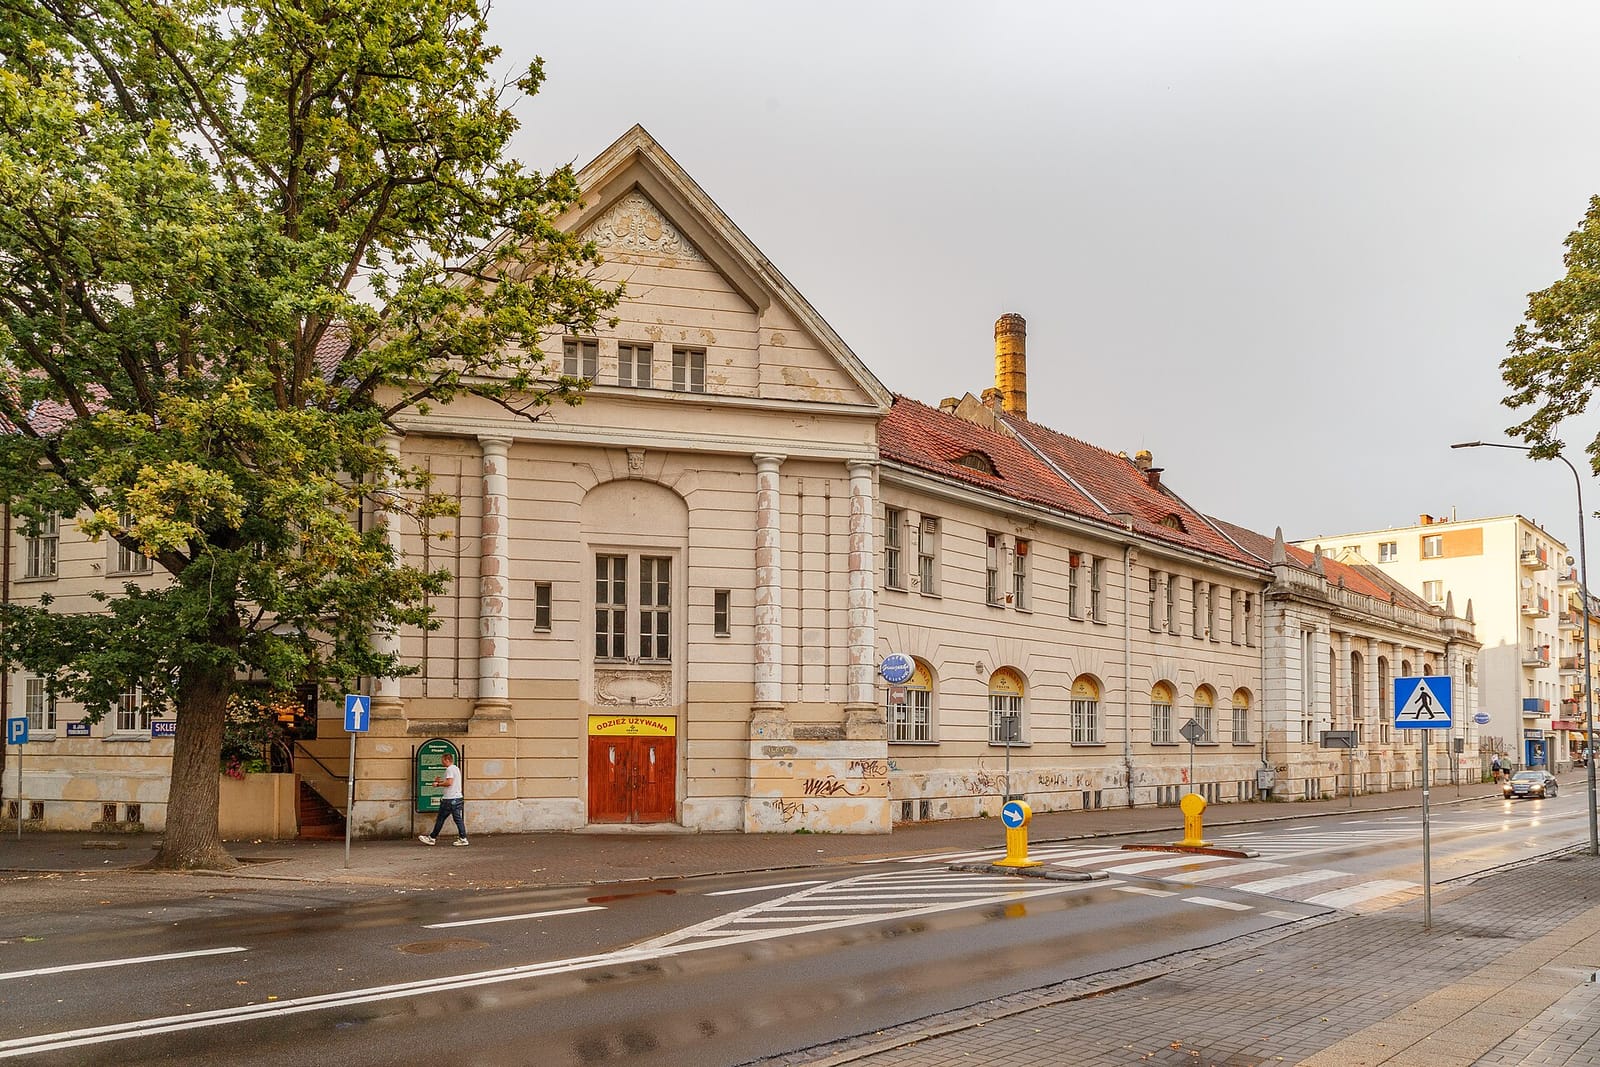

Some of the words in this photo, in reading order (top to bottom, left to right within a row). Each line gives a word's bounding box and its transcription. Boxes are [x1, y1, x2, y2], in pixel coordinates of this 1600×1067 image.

[12, 720, 25, 742] P
[596, 717, 626, 730] ODZIEŻ
[628, 717, 668, 732] UŻYWANA
